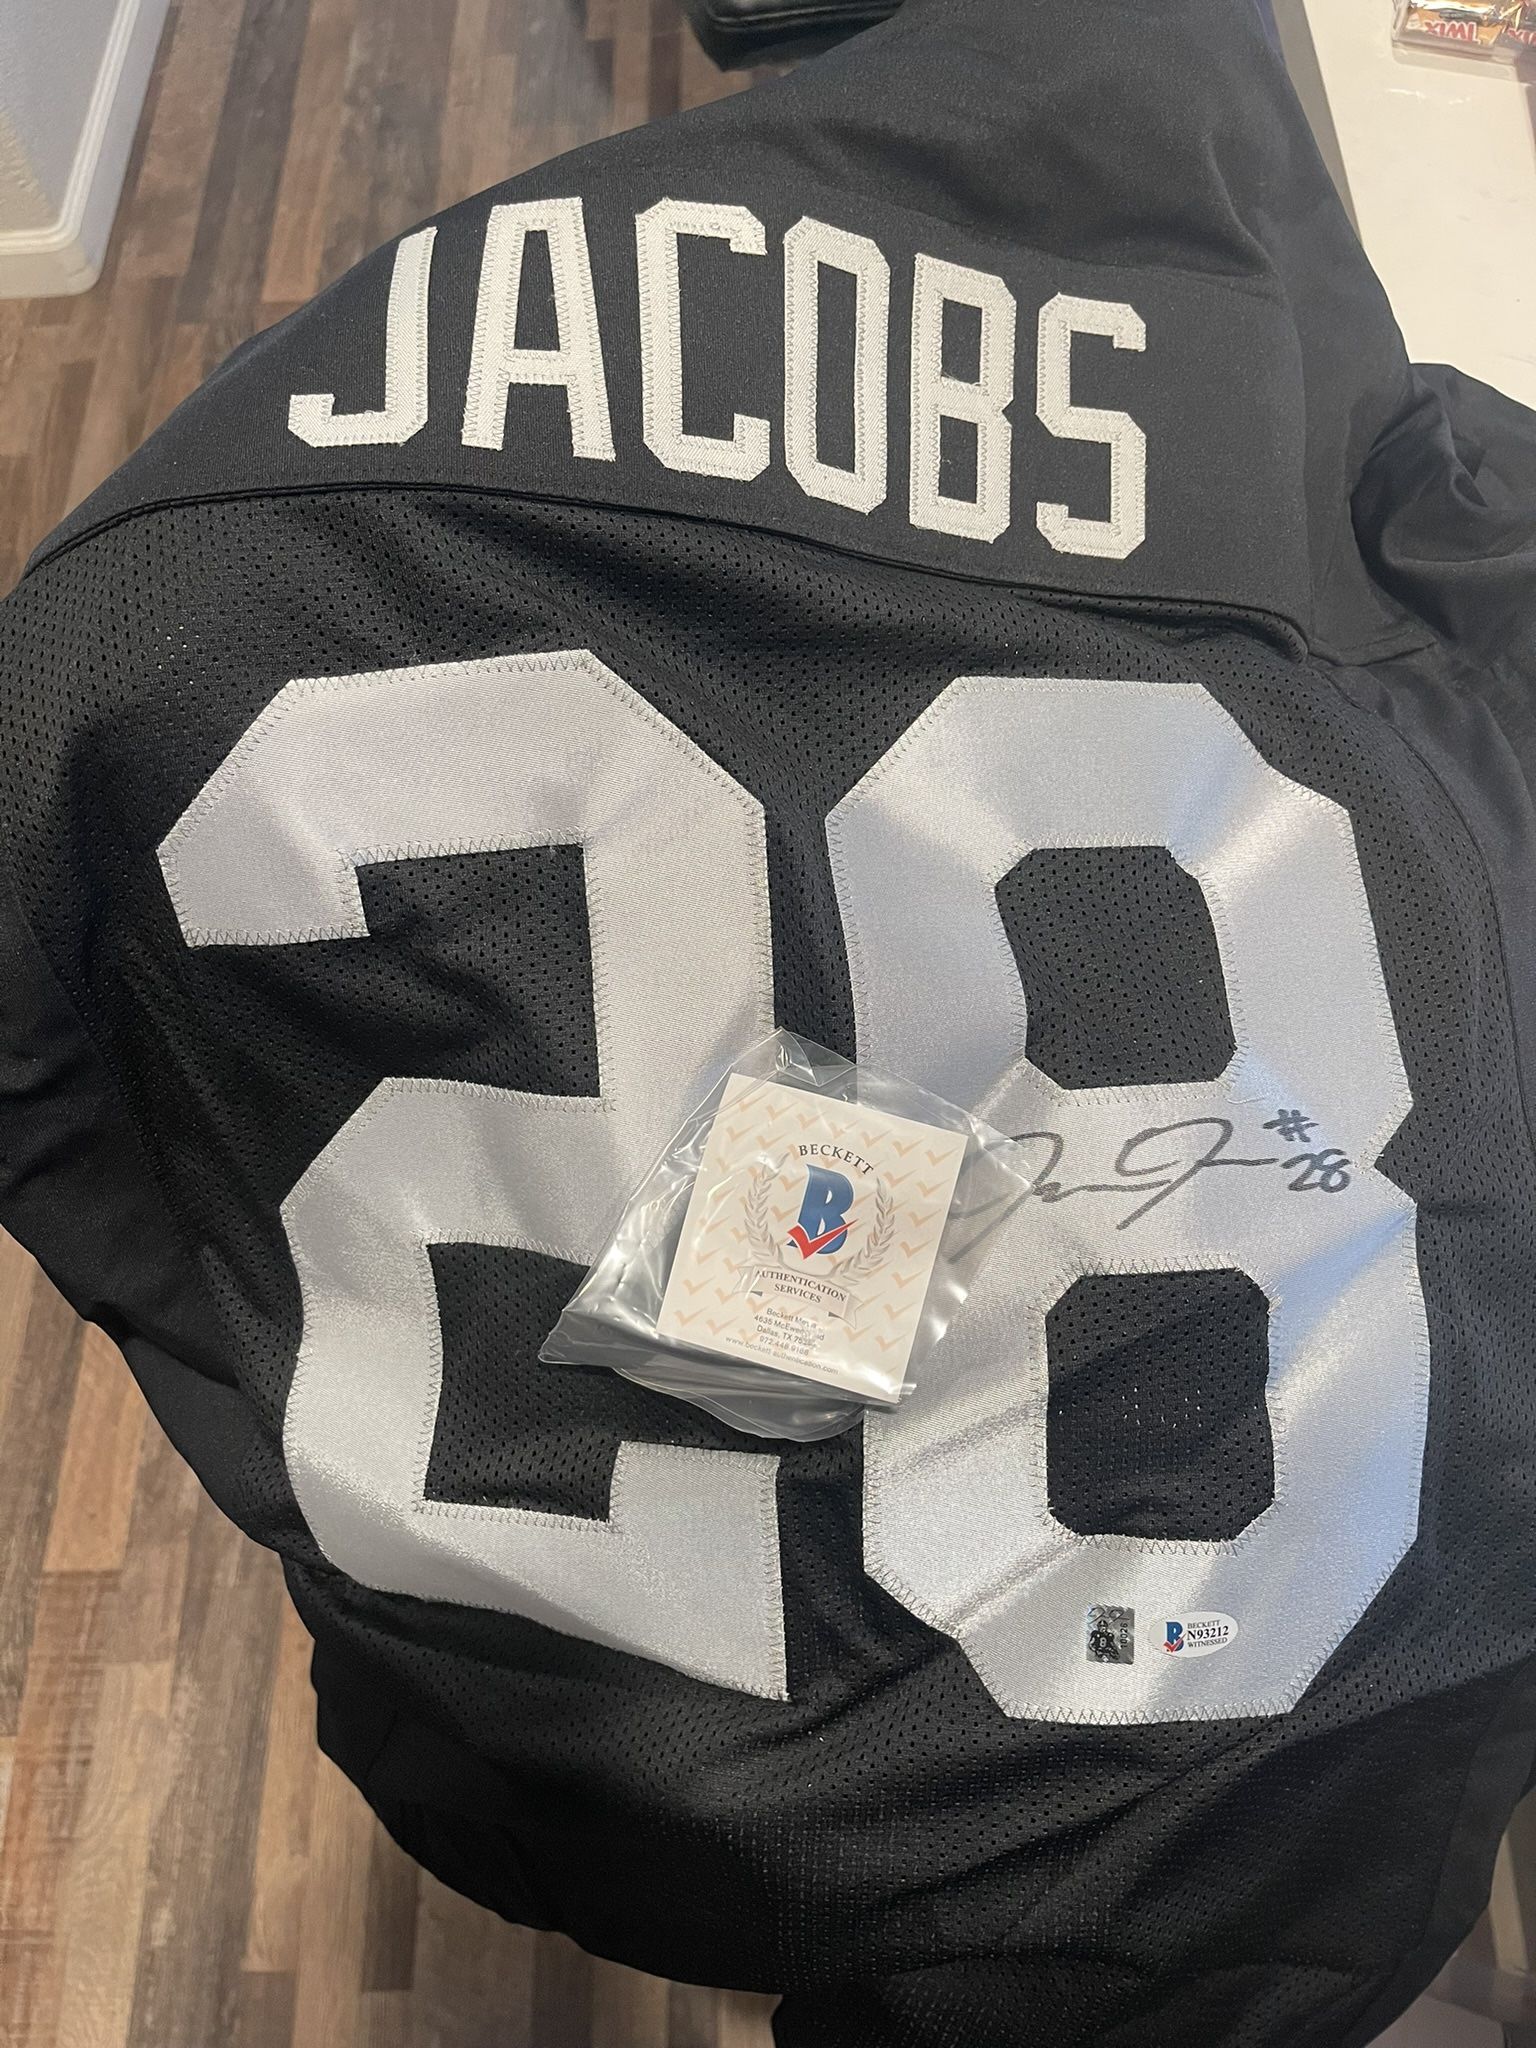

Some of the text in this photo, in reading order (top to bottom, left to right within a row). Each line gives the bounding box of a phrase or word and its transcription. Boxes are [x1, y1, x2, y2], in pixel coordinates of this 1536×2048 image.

[287, 197, 1147, 559] JACOBS
[799, 1143, 874, 1175] BECKETT
[1281, 1149, 1351, 1193] 28
[157, 649, 1430, 1724] 28
[757, 1270, 847, 1302] AUTHENTICATION
[774, 1284, 822, 1303] SERVICES
[754, 1315, 773, 1326] 4635
[766, 1308, 818, 1328] Beckett Mea
[757, 1325, 780, 1339] Dallas,
[783, 1332, 793, 1342] TX
[1187, 1619, 1221, 1630] BECKETT
[1187, 1625, 1229, 1641] N93212
[1187, 1637, 1228, 1648] WITNESSED
